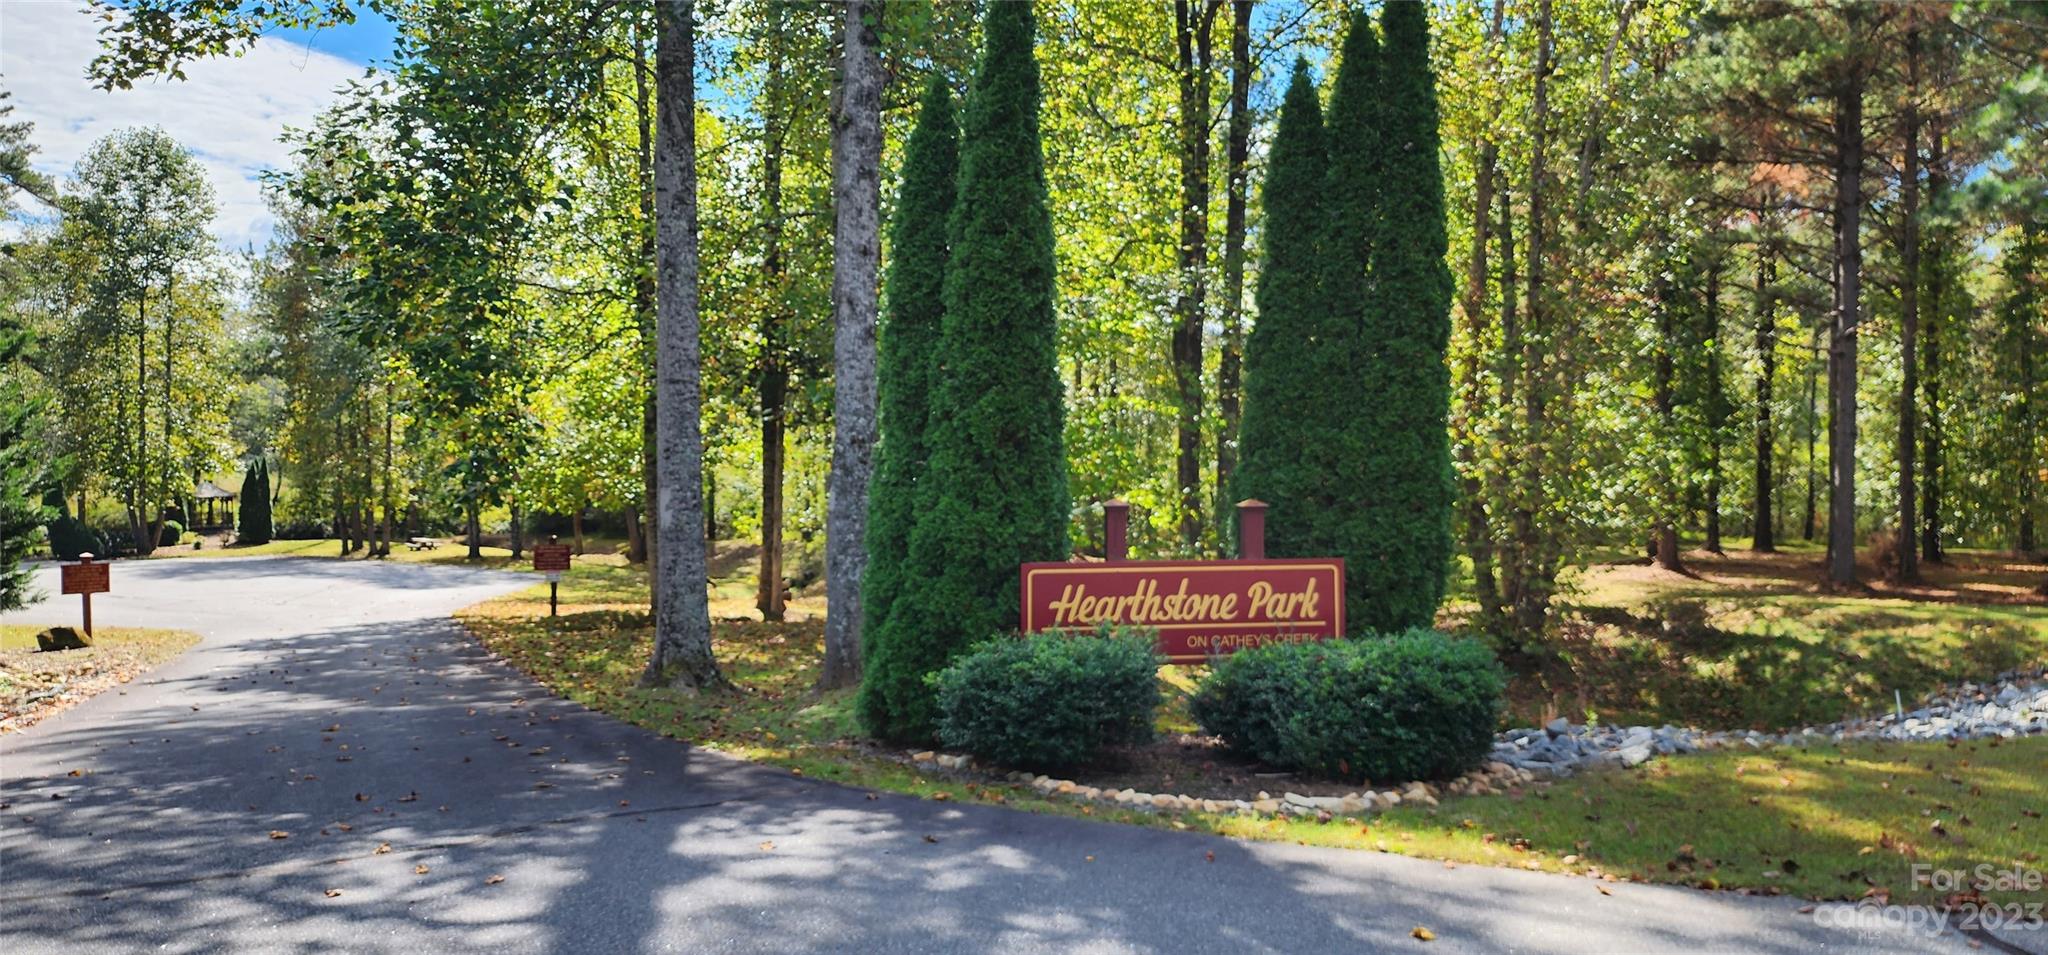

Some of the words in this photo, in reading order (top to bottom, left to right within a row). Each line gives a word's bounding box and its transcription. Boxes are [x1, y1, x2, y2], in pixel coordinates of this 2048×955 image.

[1048, 577, 1239, 622] Hearthstone
[1247, 576, 1319, 619] Park
[1186, 635, 1207, 648] ON
